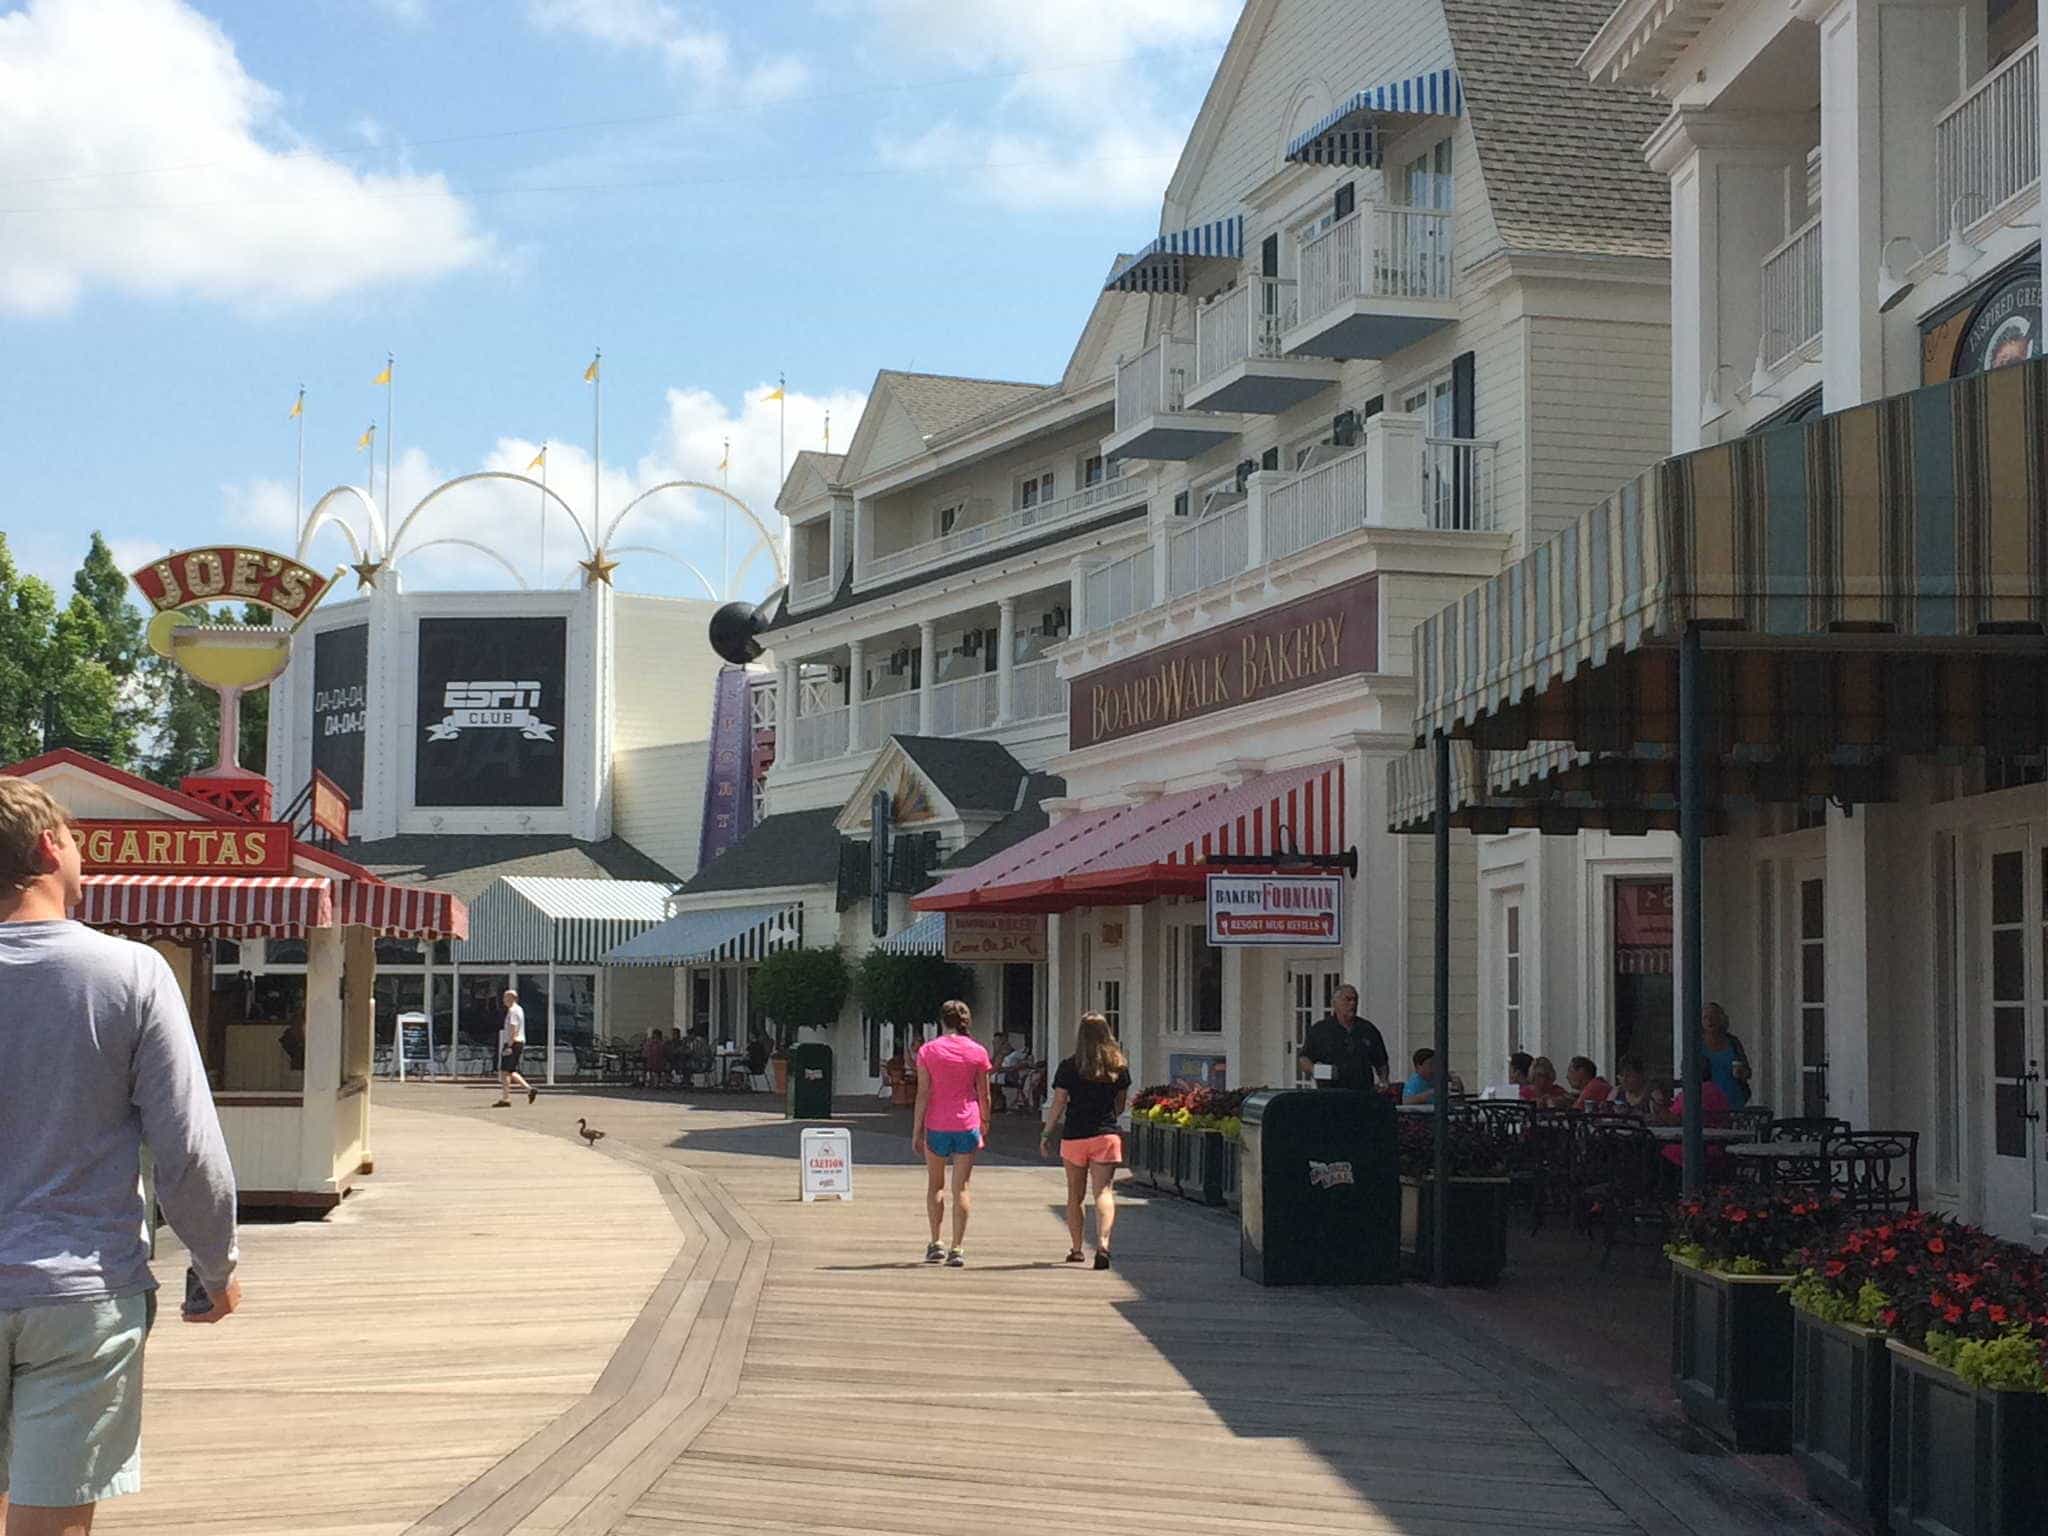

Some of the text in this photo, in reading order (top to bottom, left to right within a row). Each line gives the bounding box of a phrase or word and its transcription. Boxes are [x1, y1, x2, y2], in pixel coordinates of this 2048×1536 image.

[152, 550, 313, 609] JOE'S
[1091, 611, 1345, 740] BOARDWALK BAKERY
[444, 681, 541, 708] ESPN
[468, 712, 513, 724] CLUB
[1215, 882, 1333, 911] BAKERY FOUNTAIN
[1265, 919, 1285, 930] MUG
